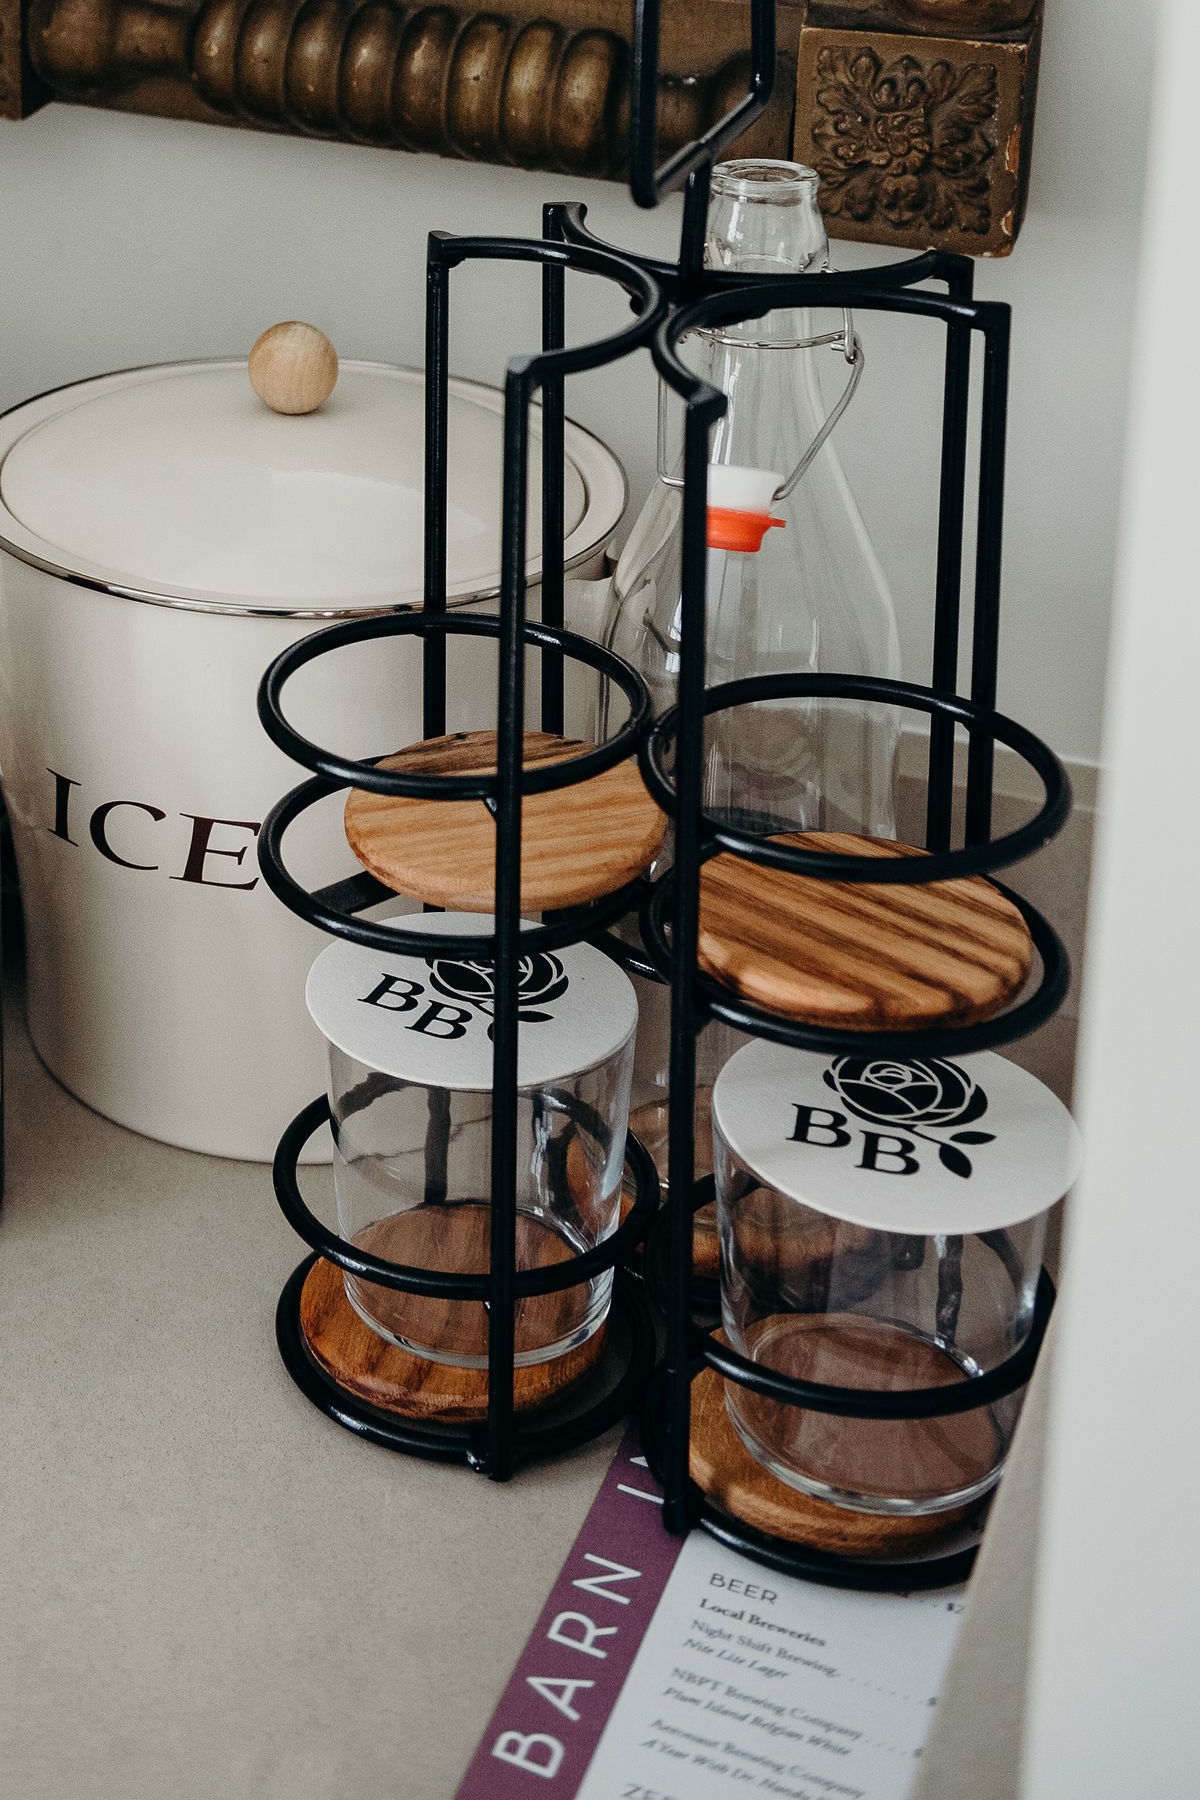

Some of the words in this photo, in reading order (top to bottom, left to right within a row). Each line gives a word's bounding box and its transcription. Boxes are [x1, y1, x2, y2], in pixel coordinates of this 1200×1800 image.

[46, 767, 262, 891] ICE
[357, 972, 473, 1040] BB
[786, 1103, 920, 1177] BB
[700, 1598, 746, 1621] Local
[748, 1613, 827, 1647] Breweries
[709, 1572, 779, 1605] BEER
[492, 1553, 642, 1779] BARN
